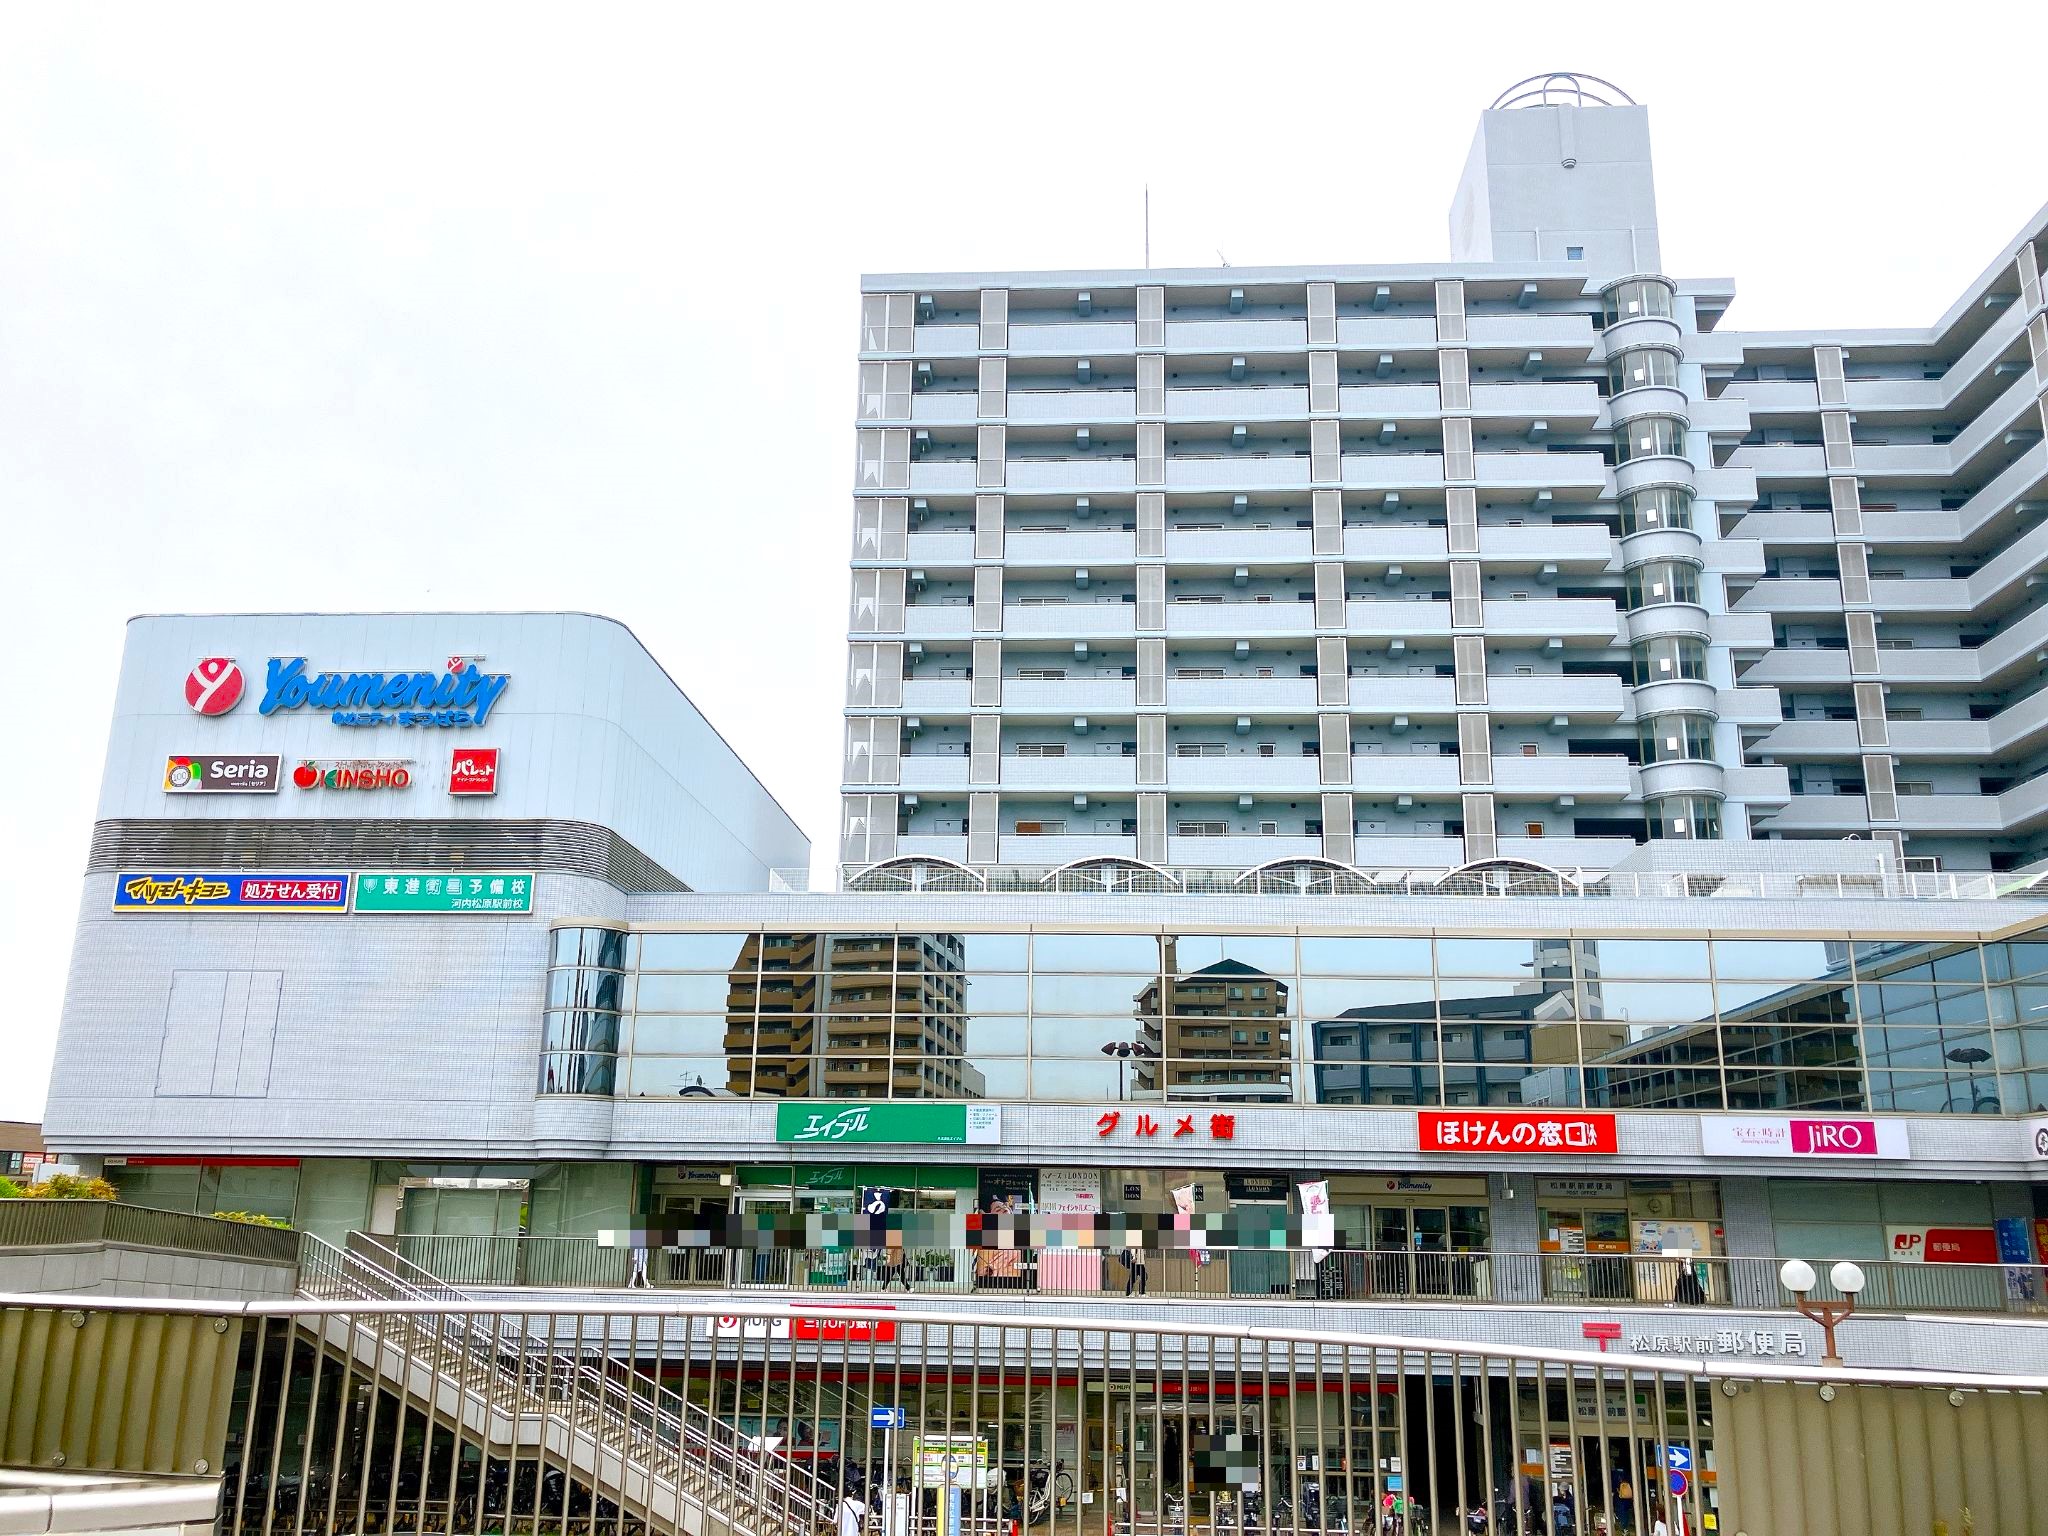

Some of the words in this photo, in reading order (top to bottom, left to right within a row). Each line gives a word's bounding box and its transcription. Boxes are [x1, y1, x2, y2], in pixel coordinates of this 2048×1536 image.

[259, 657, 507, 727] Youmenity
[210, 759, 269, 779] Seria
[452, 759, 494, 776] パレット
[320, 768, 412, 789] KINSHO
[244, 882, 339, 900] 処方せん受付
[383, 877, 525, 896] 東進衛星予備校
[451, 898, 523, 909] 河内松原駅前校
[793, 1106, 871, 1139] エイブル
[1096, 1111, 1235, 1140] グルメ街
[1436, 1120, 1589, 1146] ほけんの窓口
[1807, 1124, 1863, 1154] JiRO
[805, 1167, 845, 1184] エイブル
[1397, 1180, 1432, 1191] Youmenity
[1895, 1234, 1921, 1249] JP
[1933, 1242, 1961, 1251] 郵便局
[1630, 1329, 1806, 1355] 松原駅前郵便局
[1578, 1407, 1646, 1417] 松原前郵局
